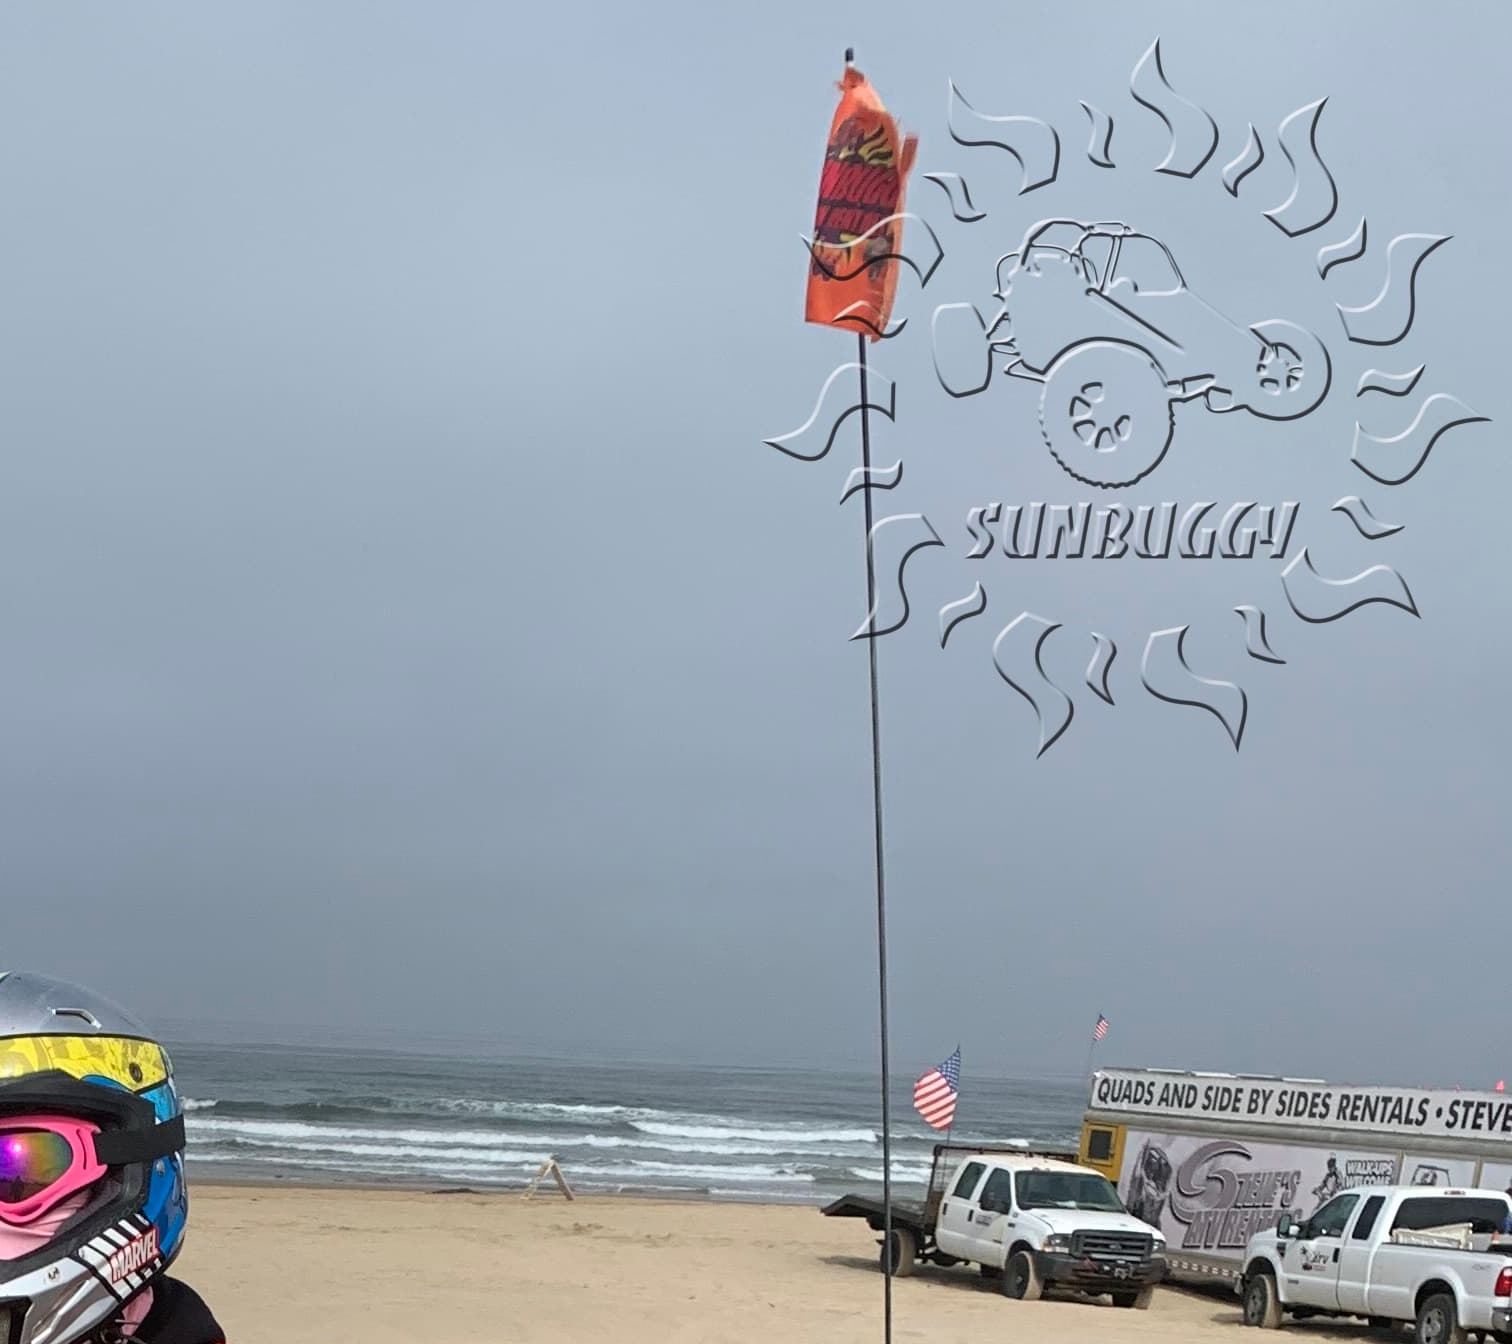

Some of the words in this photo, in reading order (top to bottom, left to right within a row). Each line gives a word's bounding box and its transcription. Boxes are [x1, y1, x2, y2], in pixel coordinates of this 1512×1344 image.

[1097, 1078, 1155, 1106] QUADS
[1158, 1082, 1198, 1109] AND
[1201, 1086, 1243, 1113] SIDE
[1247, 1088, 1274, 1115] BY
[1275, 1091, 1332, 1119] SIDES
[1336, 1094, 1430, 1127] RENTALS
[110, 1228, 160, 1281] MARVEL
